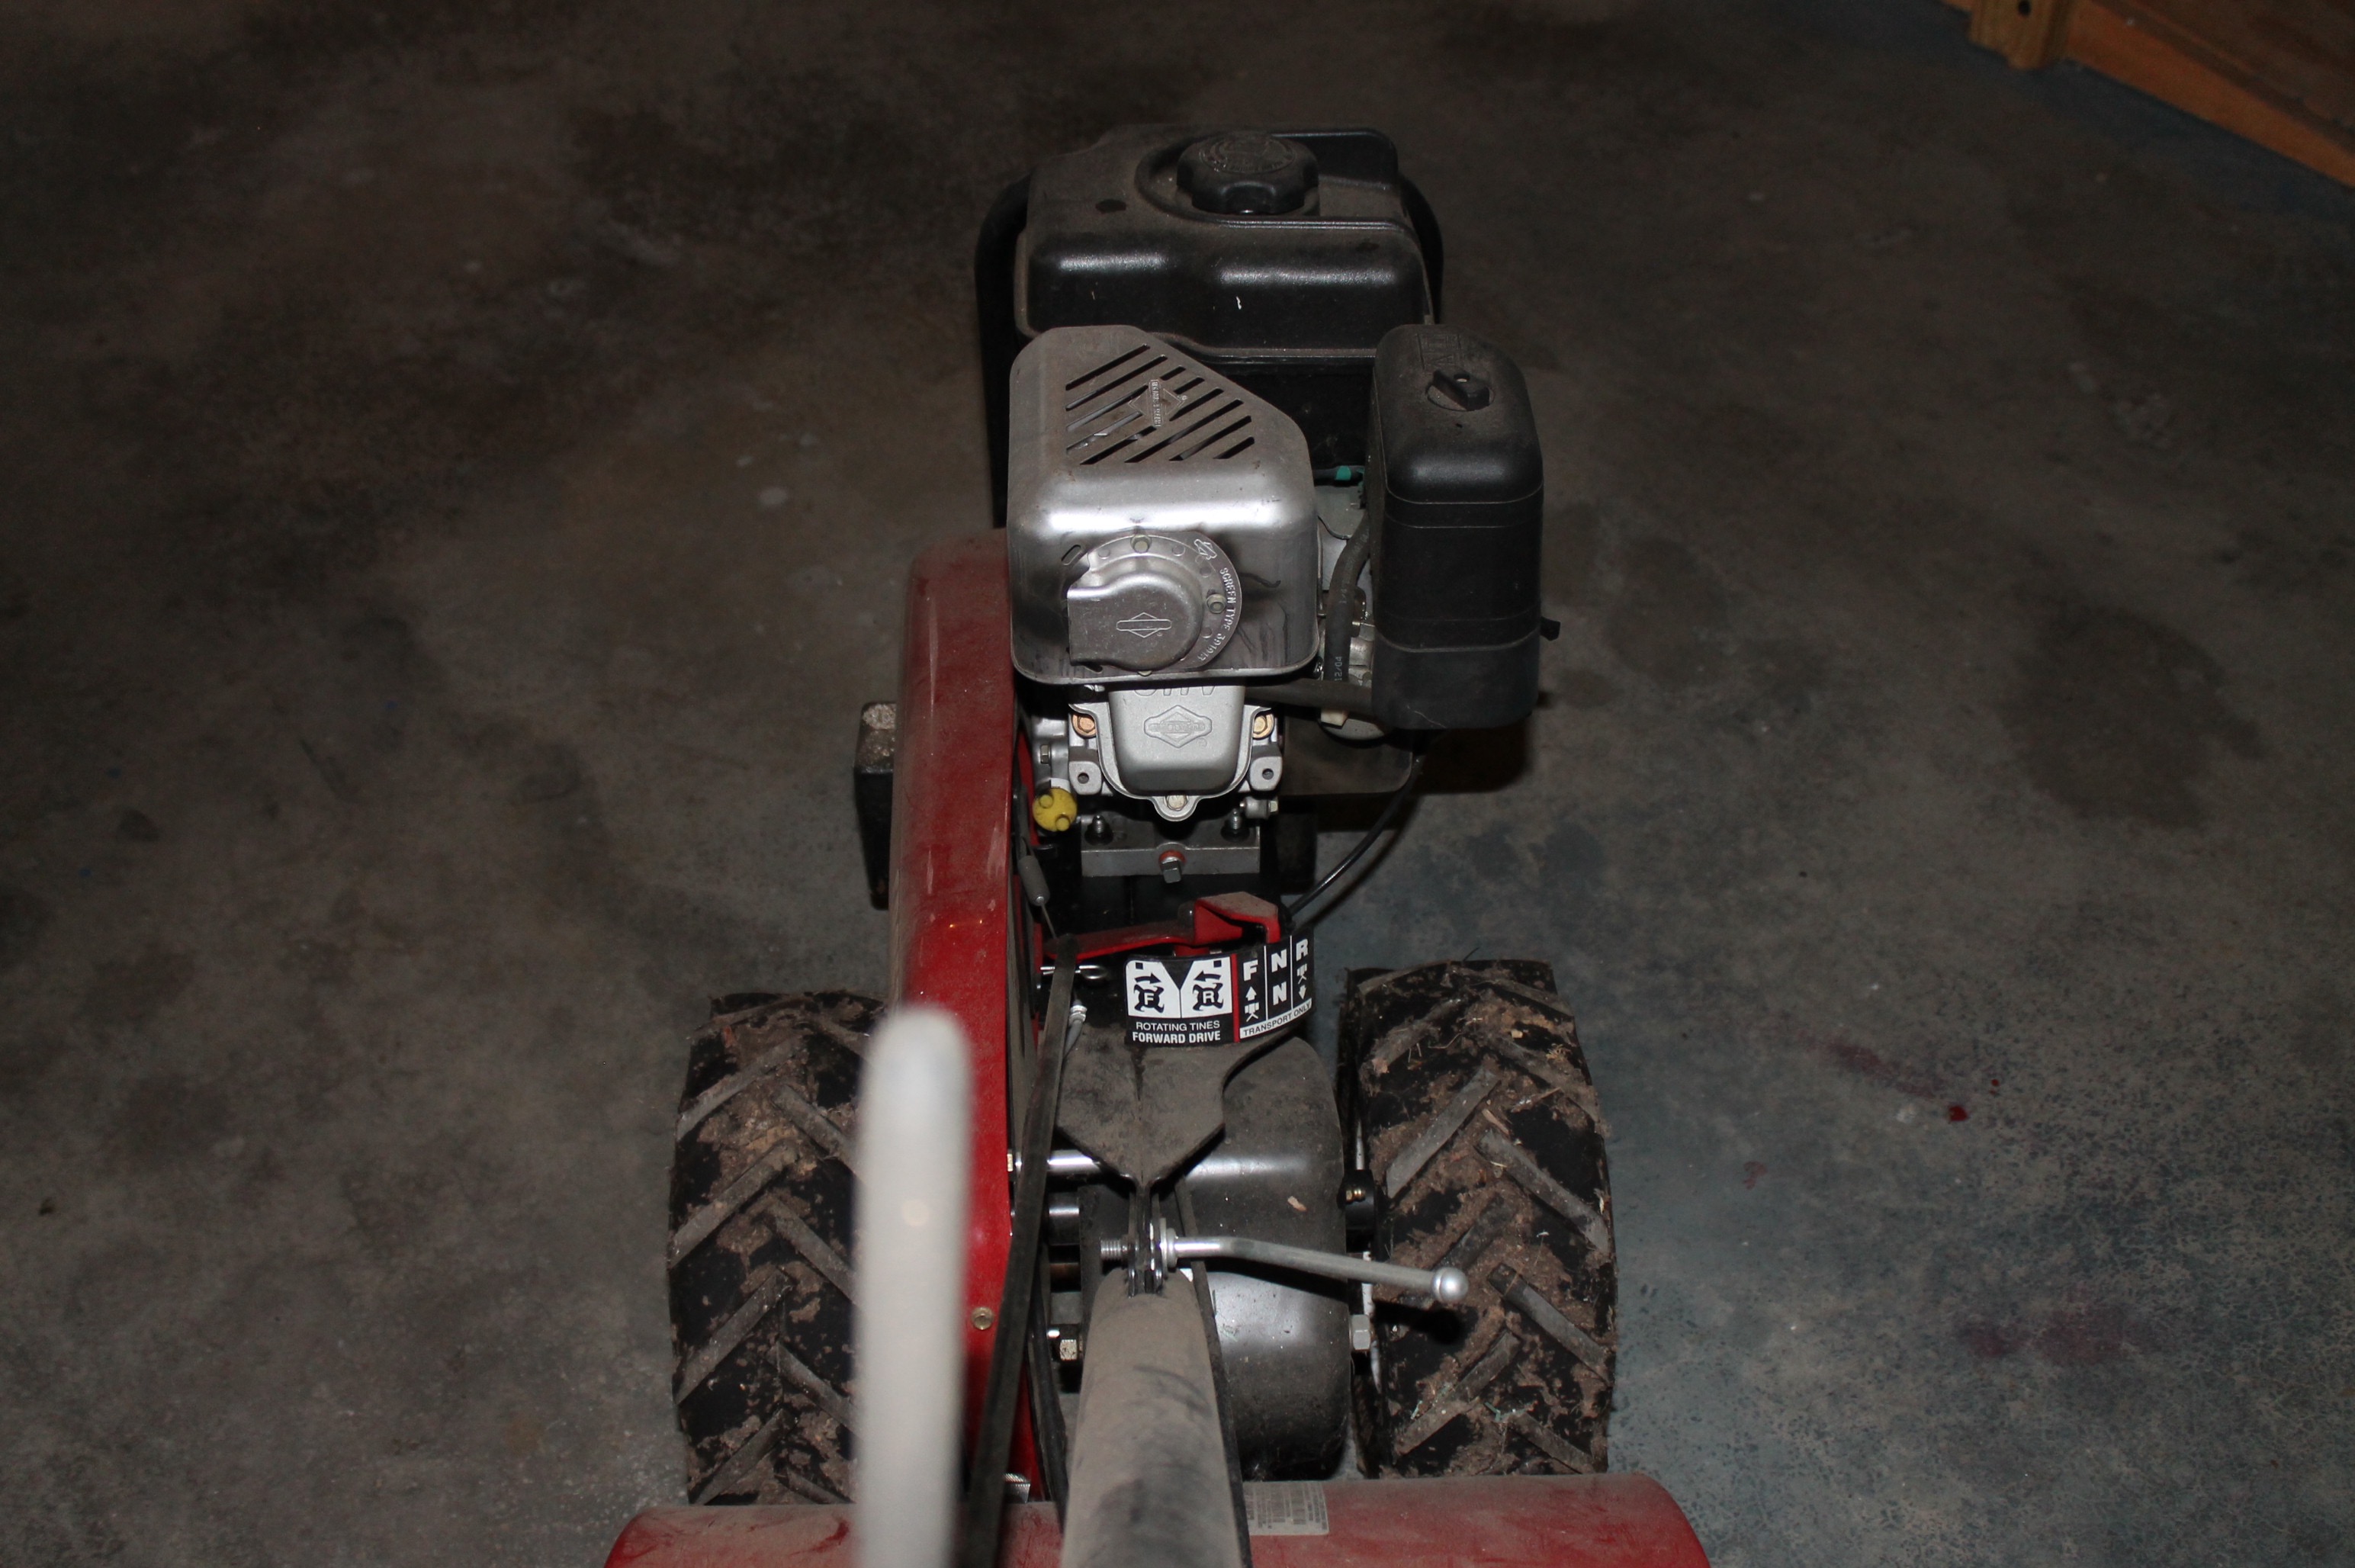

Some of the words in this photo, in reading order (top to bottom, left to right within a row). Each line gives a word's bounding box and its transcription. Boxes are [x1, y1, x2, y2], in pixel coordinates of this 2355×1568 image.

[1219, 567, 1237, 604] SCREEN
[1223, 607, 1236, 631] TYPE
[1271, 948, 1287, 973] N
[1296, 938, 1309, 961] R
[1242, 959, 1258, 982] F
[1144, 992, 1155, 1006] F
[1203, 991, 1216, 1004] R
[1272, 981, 1287, 1006] N
[1136, 1021, 1187, 1032] ROTATING
[1190, 1020, 1220, 1031] TINES
[1243, 1013, 1293, 1036] TRANSPORT
[1293, 1001, 1310, 1017] ONLY
[1132, 1031, 1186, 1044] FORWARD
[1189, 1030, 1221, 1043] DRIVE
